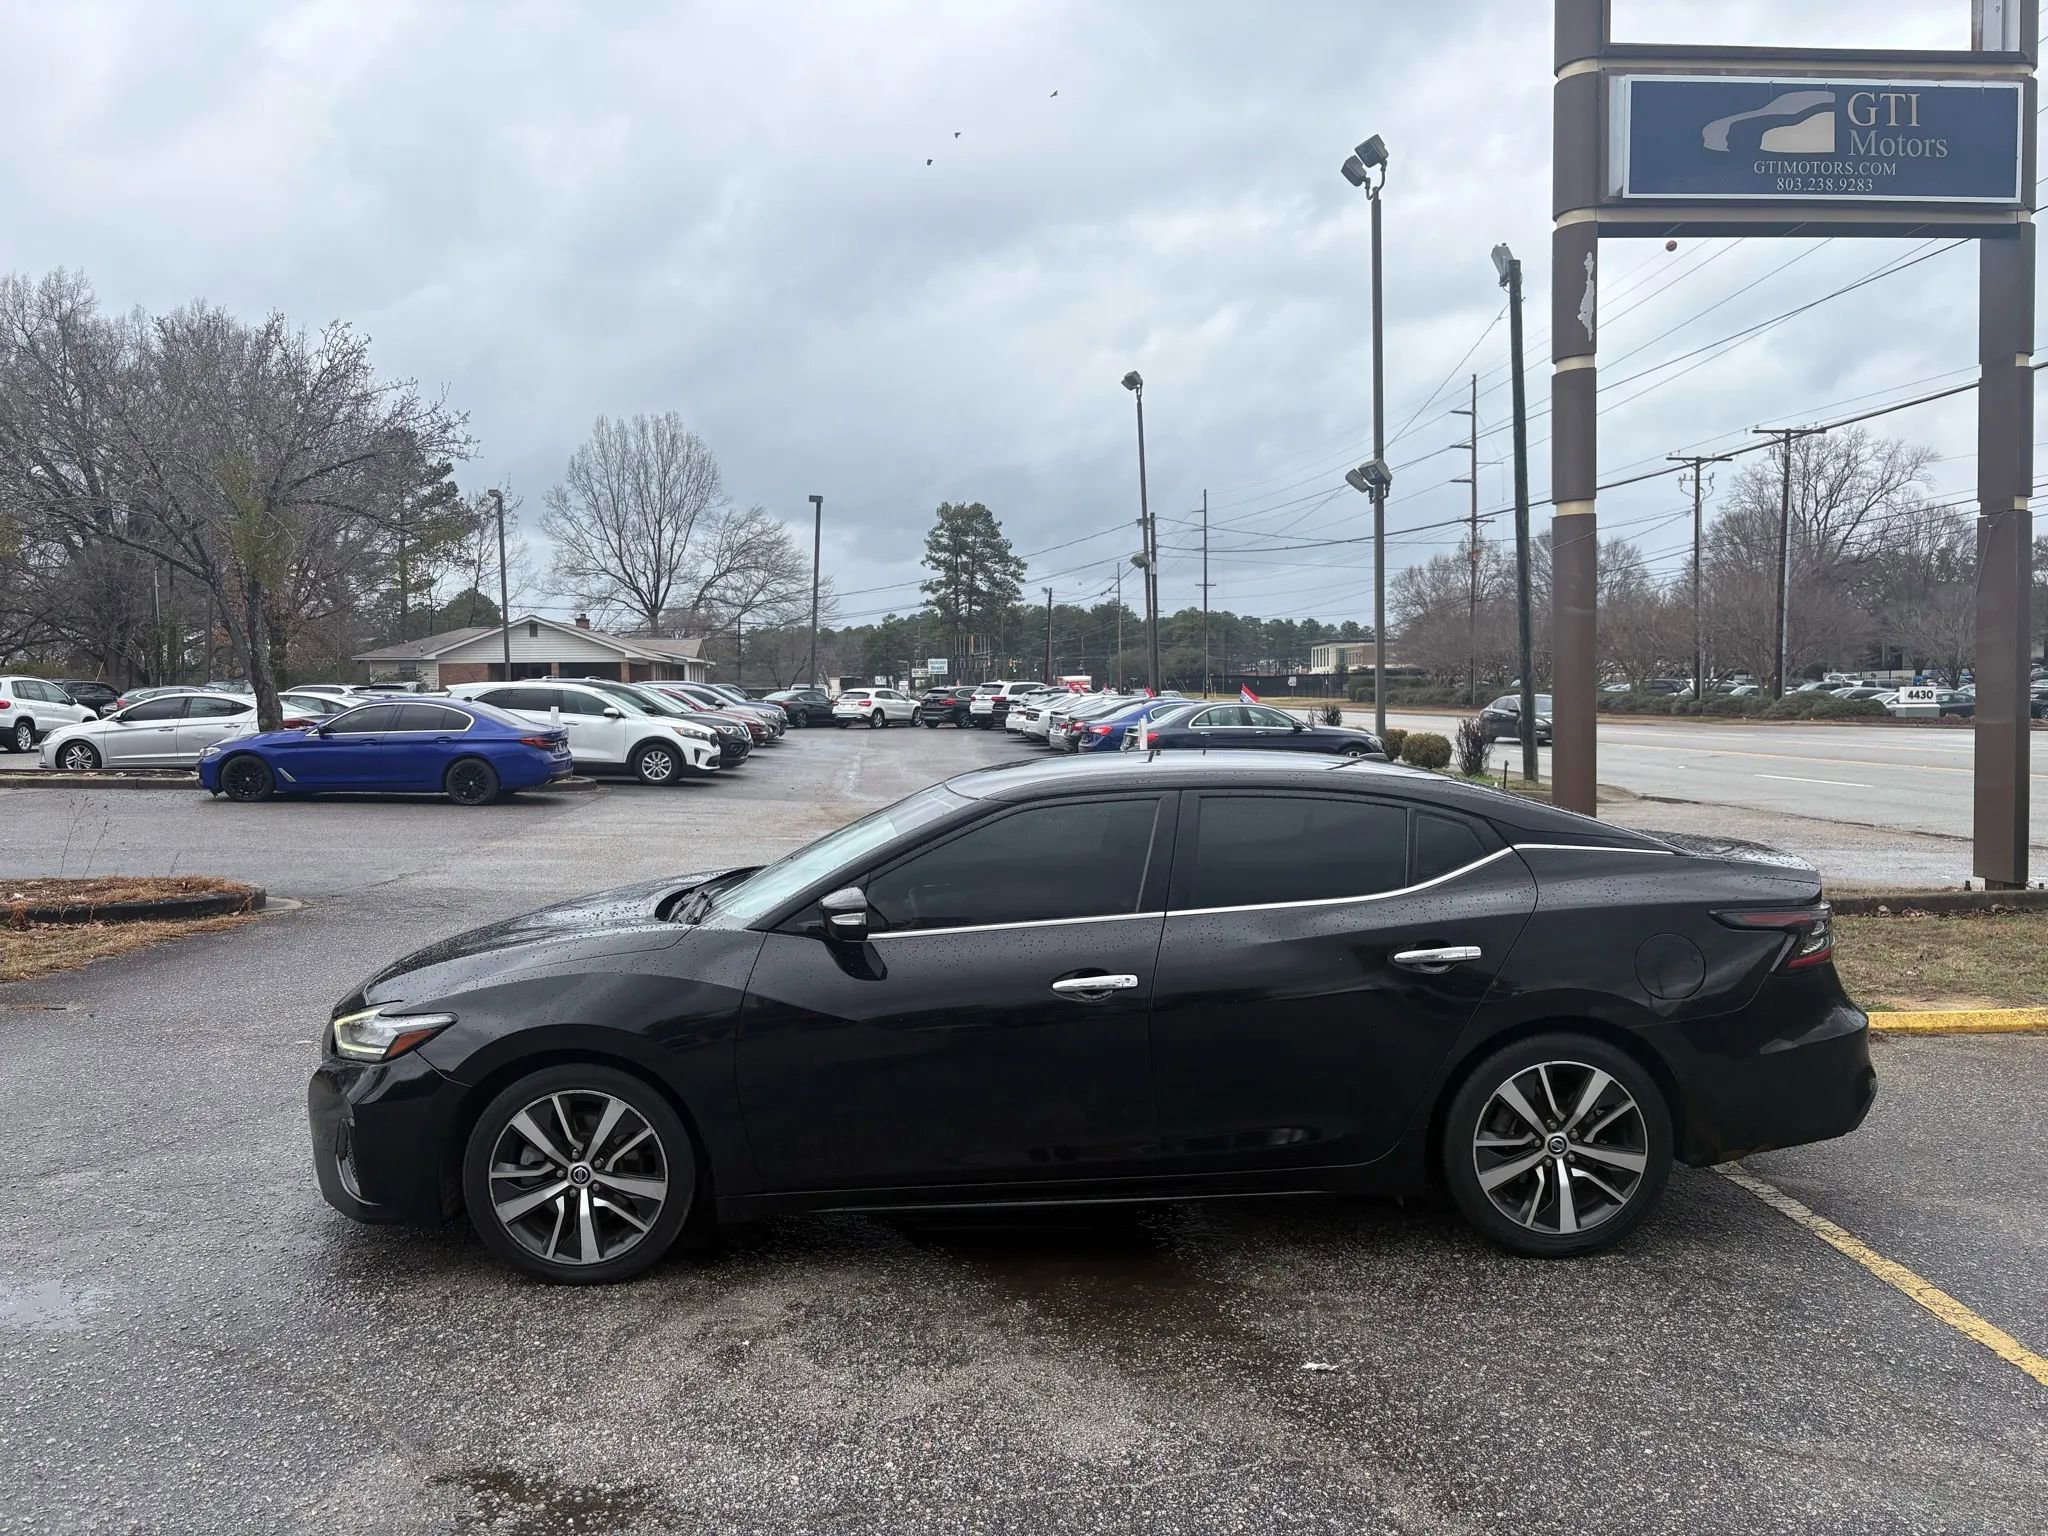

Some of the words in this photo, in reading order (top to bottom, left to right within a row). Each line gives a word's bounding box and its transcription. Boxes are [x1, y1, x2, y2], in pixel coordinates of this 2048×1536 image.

[1847, 91, 1921, 127] GTI
[1847, 129, 1948, 158] Motors
[1753, 160, 1896, 175] GTIMOTORS.COM
[1776, 177, 1873, 192] 803.238.9283
[1907, 690, 1934, 700] 4430
